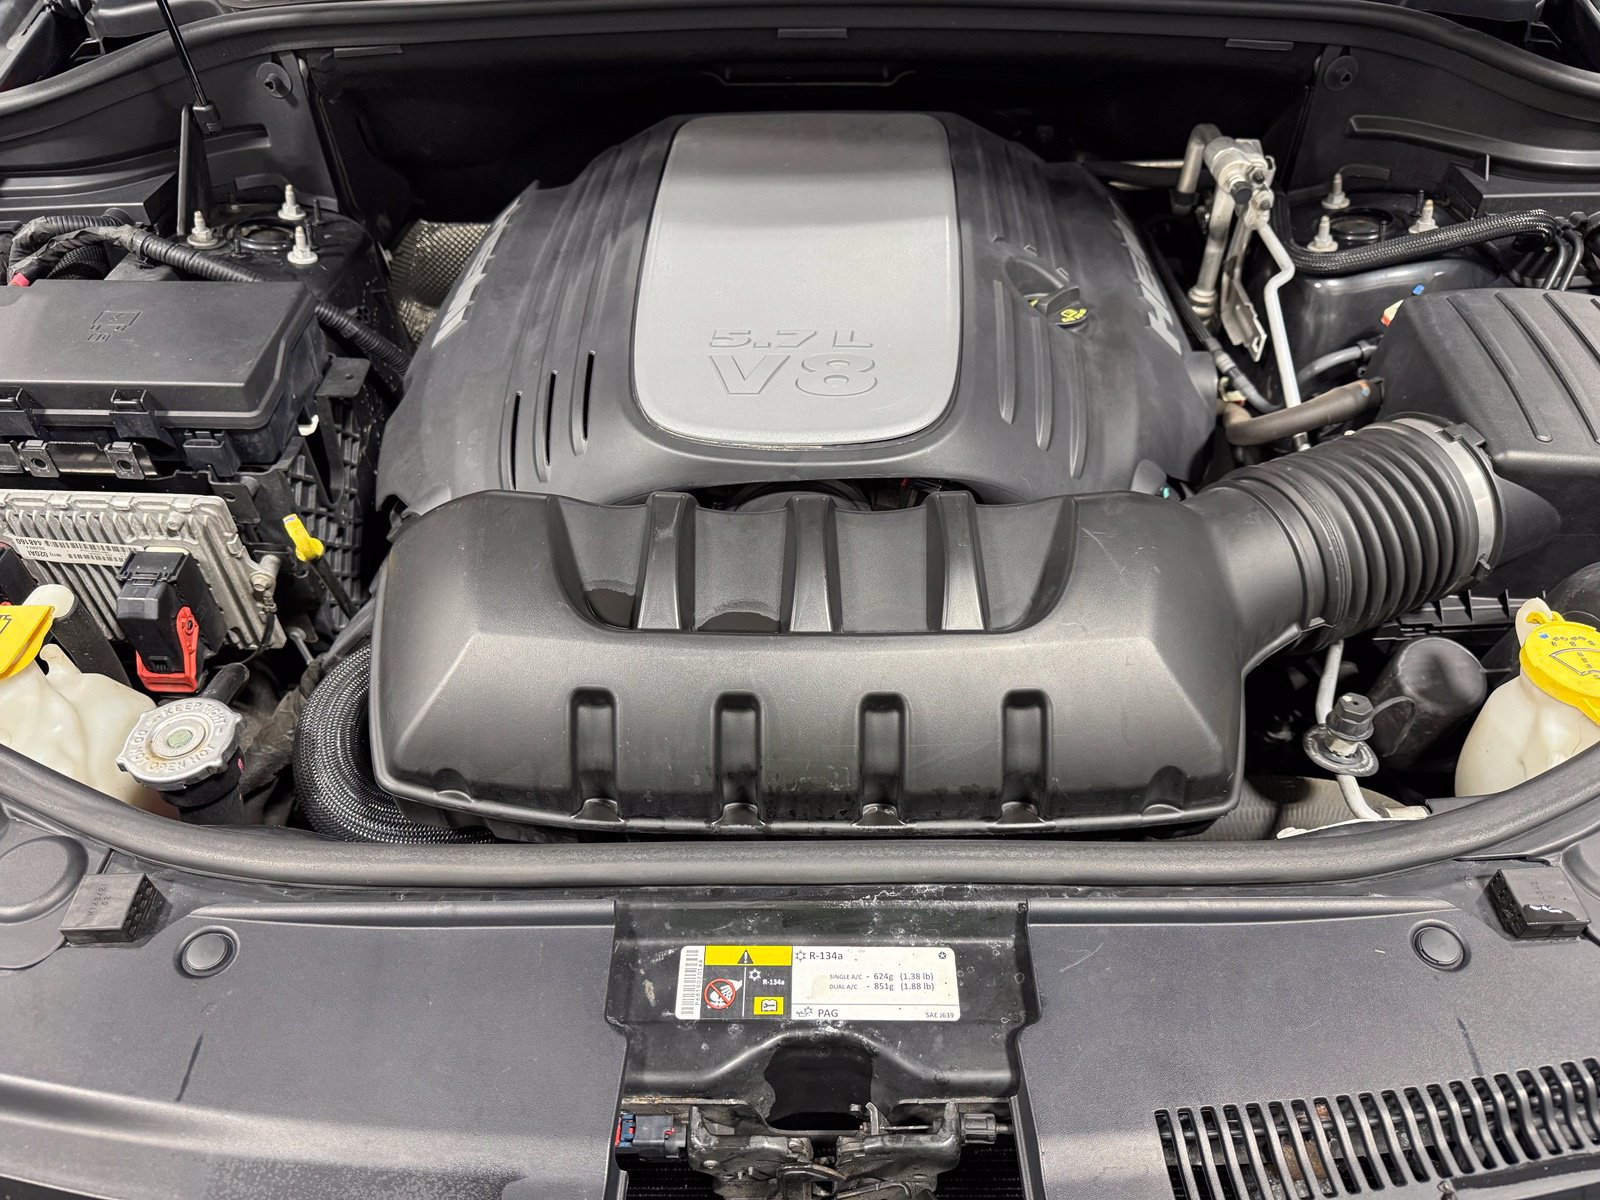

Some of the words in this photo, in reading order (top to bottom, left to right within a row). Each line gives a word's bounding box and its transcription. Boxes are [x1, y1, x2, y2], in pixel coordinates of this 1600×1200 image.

[709, 354, 878, 397] V8
[163, 701, 202, 717] KEEP
[203, 703, 227, 726] TIGHT
[149, 761, 186, 772] OPEN
[191, 743, 216, 764] HOT
[809, 951, 843, 960] R-134a
[873, 972, 894, 982] 624g
[899, 972, 921, 982] (1.38
[922, 972, 934, 981] lb)
[873, 982, 895, 992] 851g
[900, 982, 922, 992] (1.88
[923, 982, 935, 992] lb)
[818, 1008, 839, 1018] PAG
[939, 1011, 955, 1019] J639
